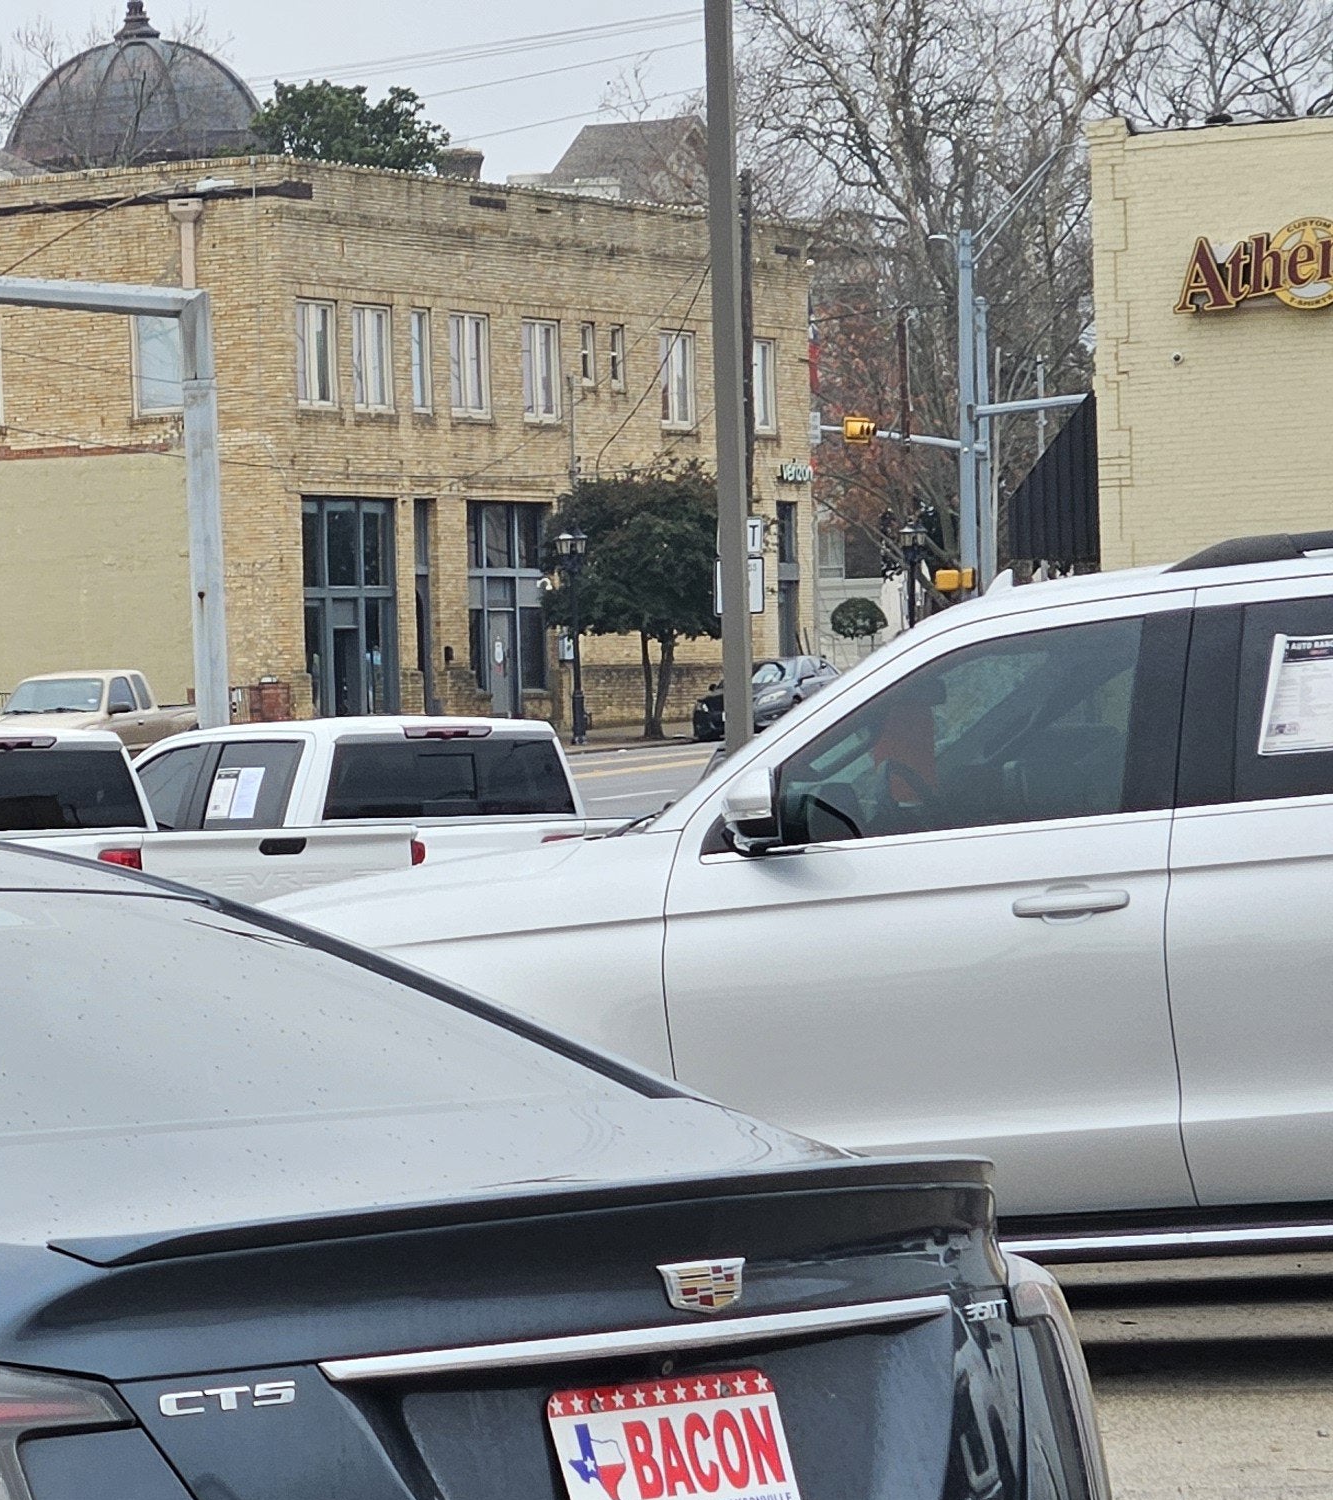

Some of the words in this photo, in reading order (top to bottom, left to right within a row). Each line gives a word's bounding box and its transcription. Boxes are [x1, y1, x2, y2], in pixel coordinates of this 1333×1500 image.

[1286, 219, 1332, 234] CUSTOM
[159, 1380, 296, 1417] CT5
[621, 1404, 787, 1500] BACON
